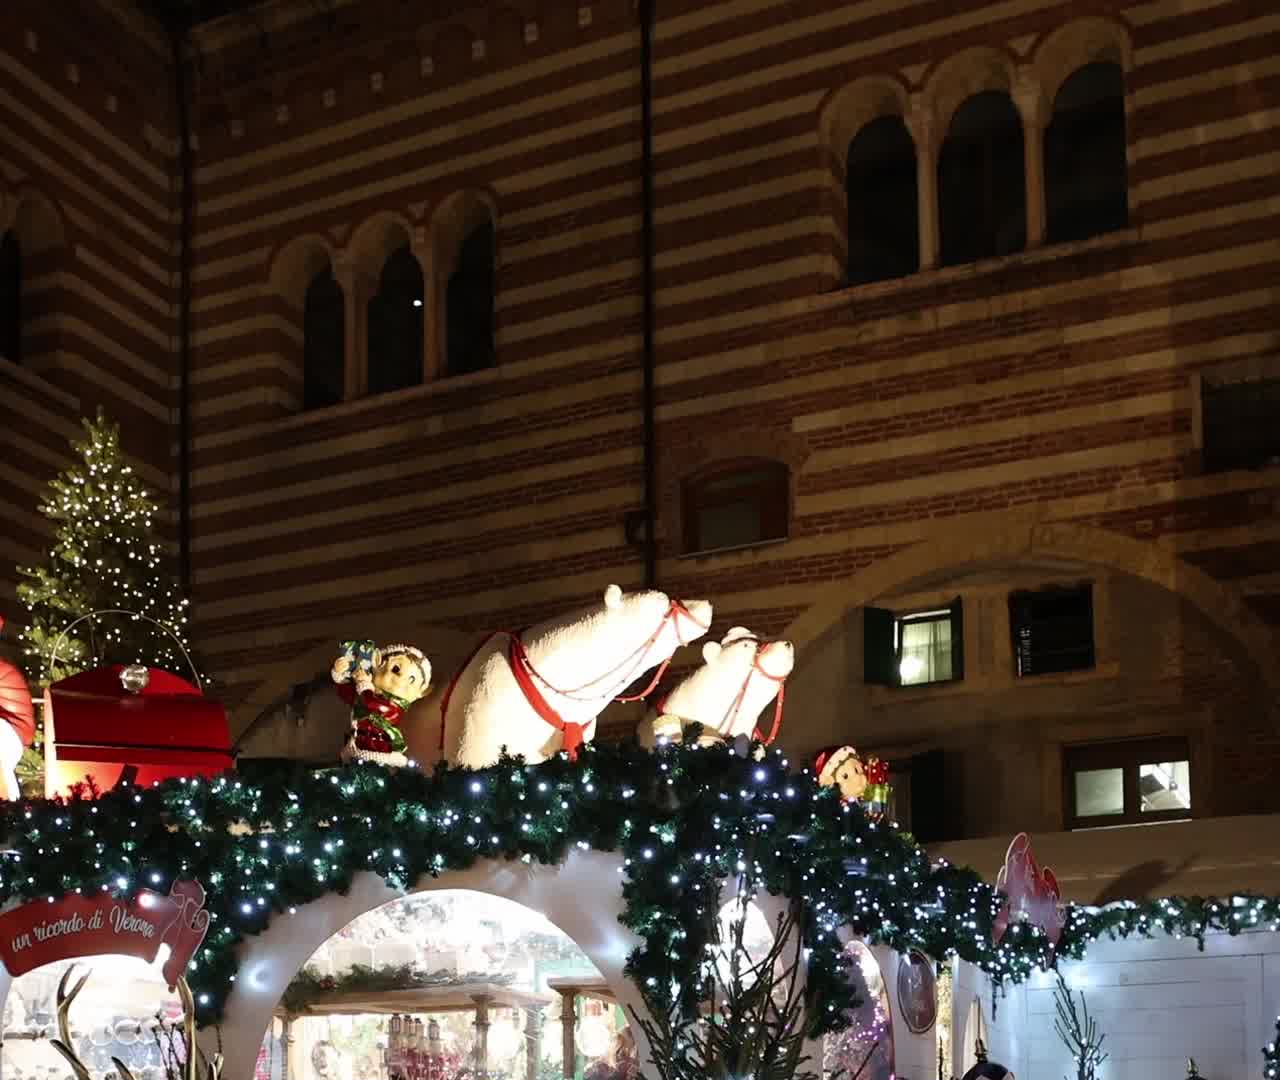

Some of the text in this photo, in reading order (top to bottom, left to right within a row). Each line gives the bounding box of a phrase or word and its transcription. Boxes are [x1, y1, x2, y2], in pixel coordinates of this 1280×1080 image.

[12, 904, 155, 952] un ricordo di Verona
